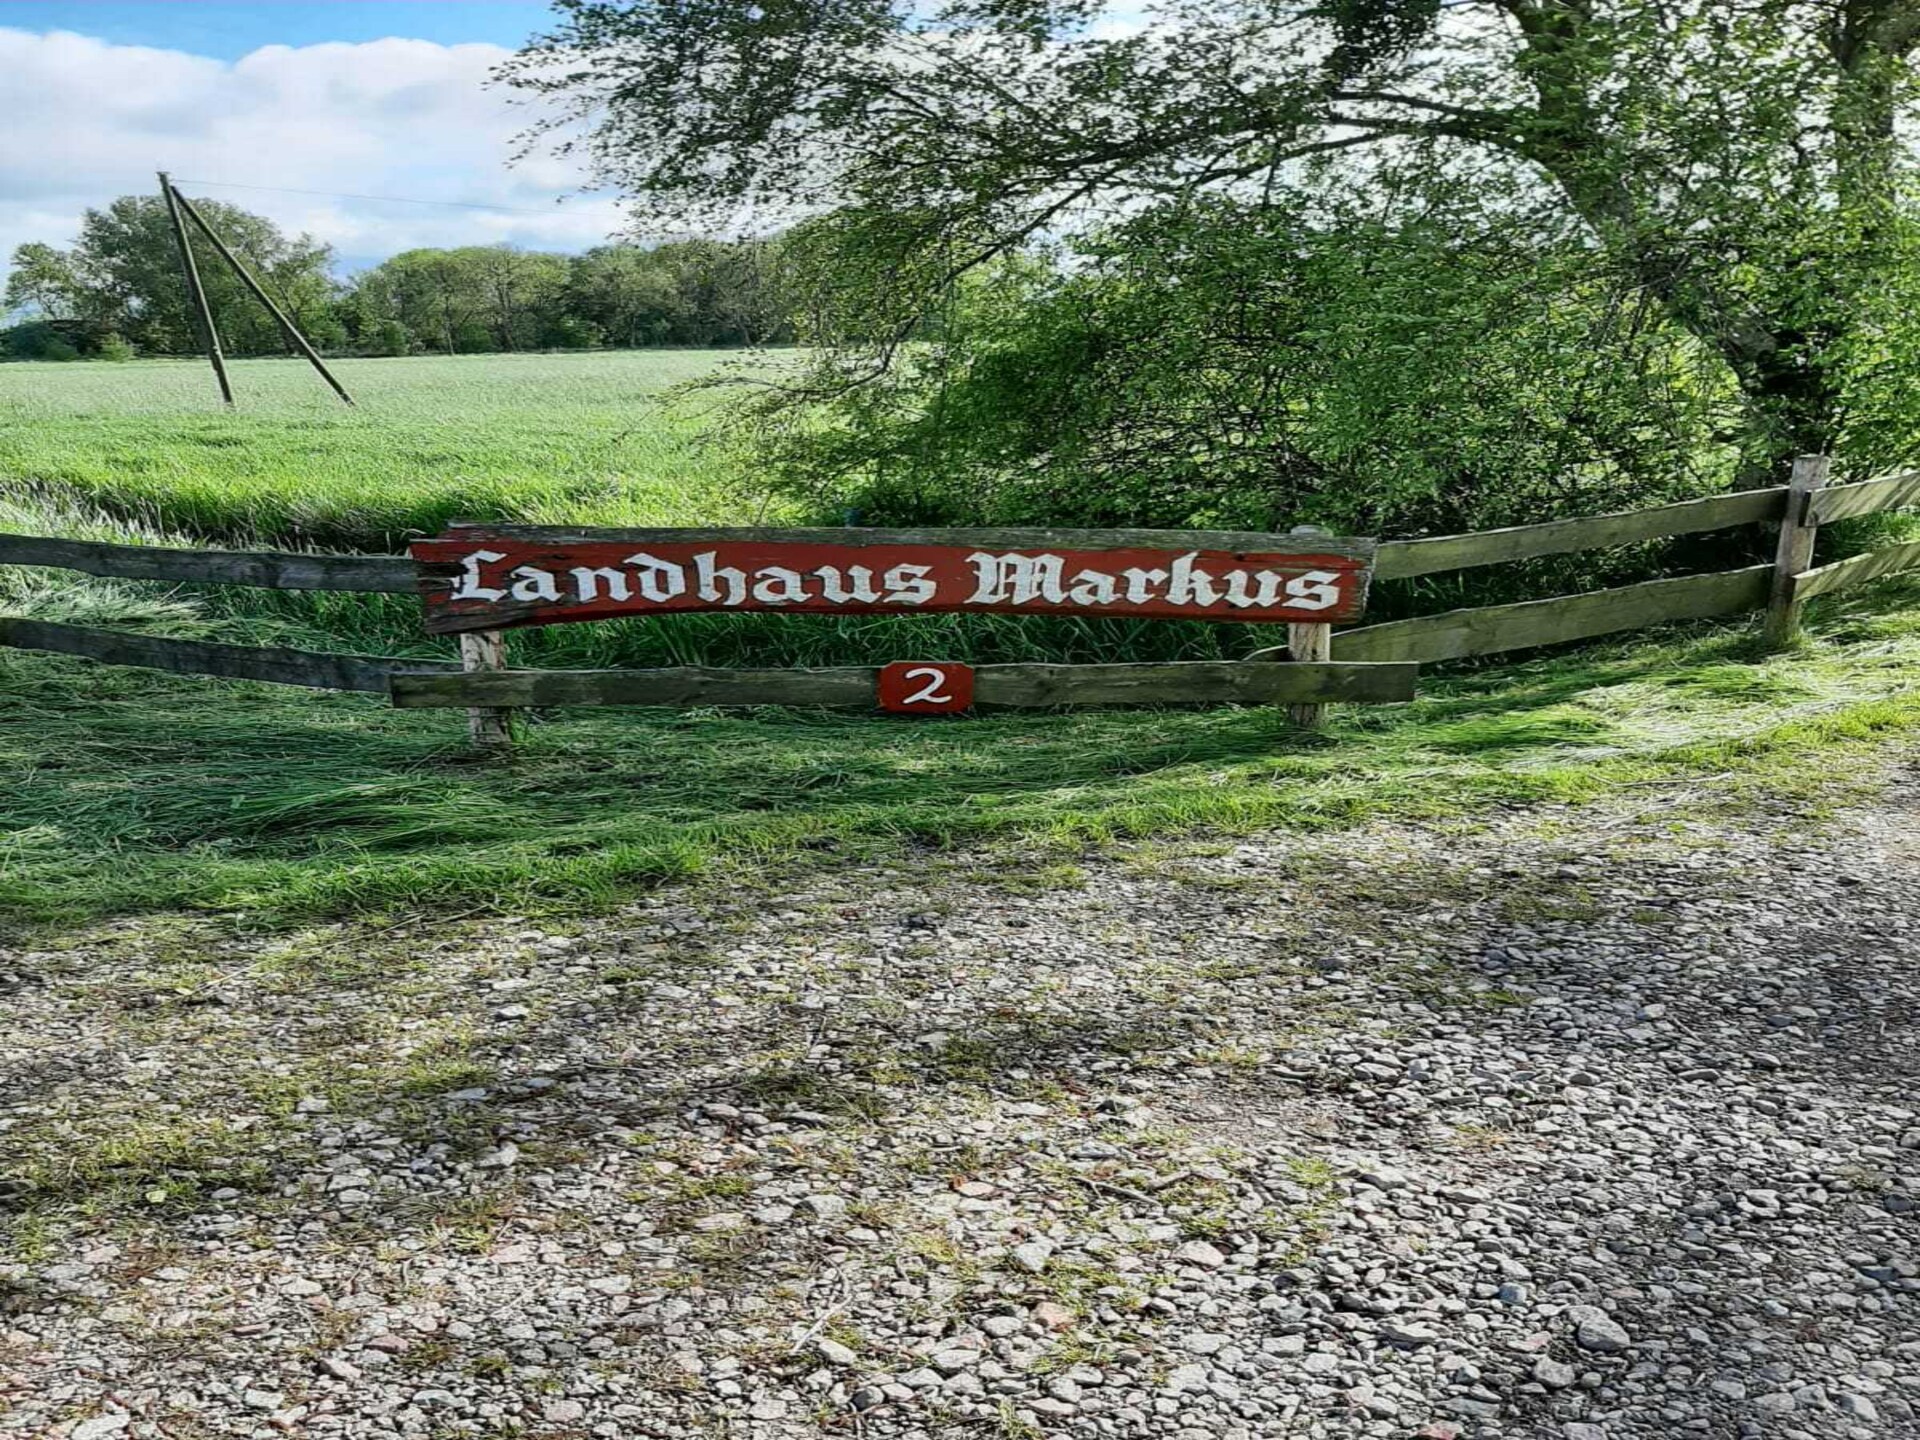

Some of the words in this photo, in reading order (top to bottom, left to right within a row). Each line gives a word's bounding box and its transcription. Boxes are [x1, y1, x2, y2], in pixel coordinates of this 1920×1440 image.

[449, 550, 937, 606] Landhaus
[964, 551, 1341, 610] Markus
[903, 667, 952, 704] 2
